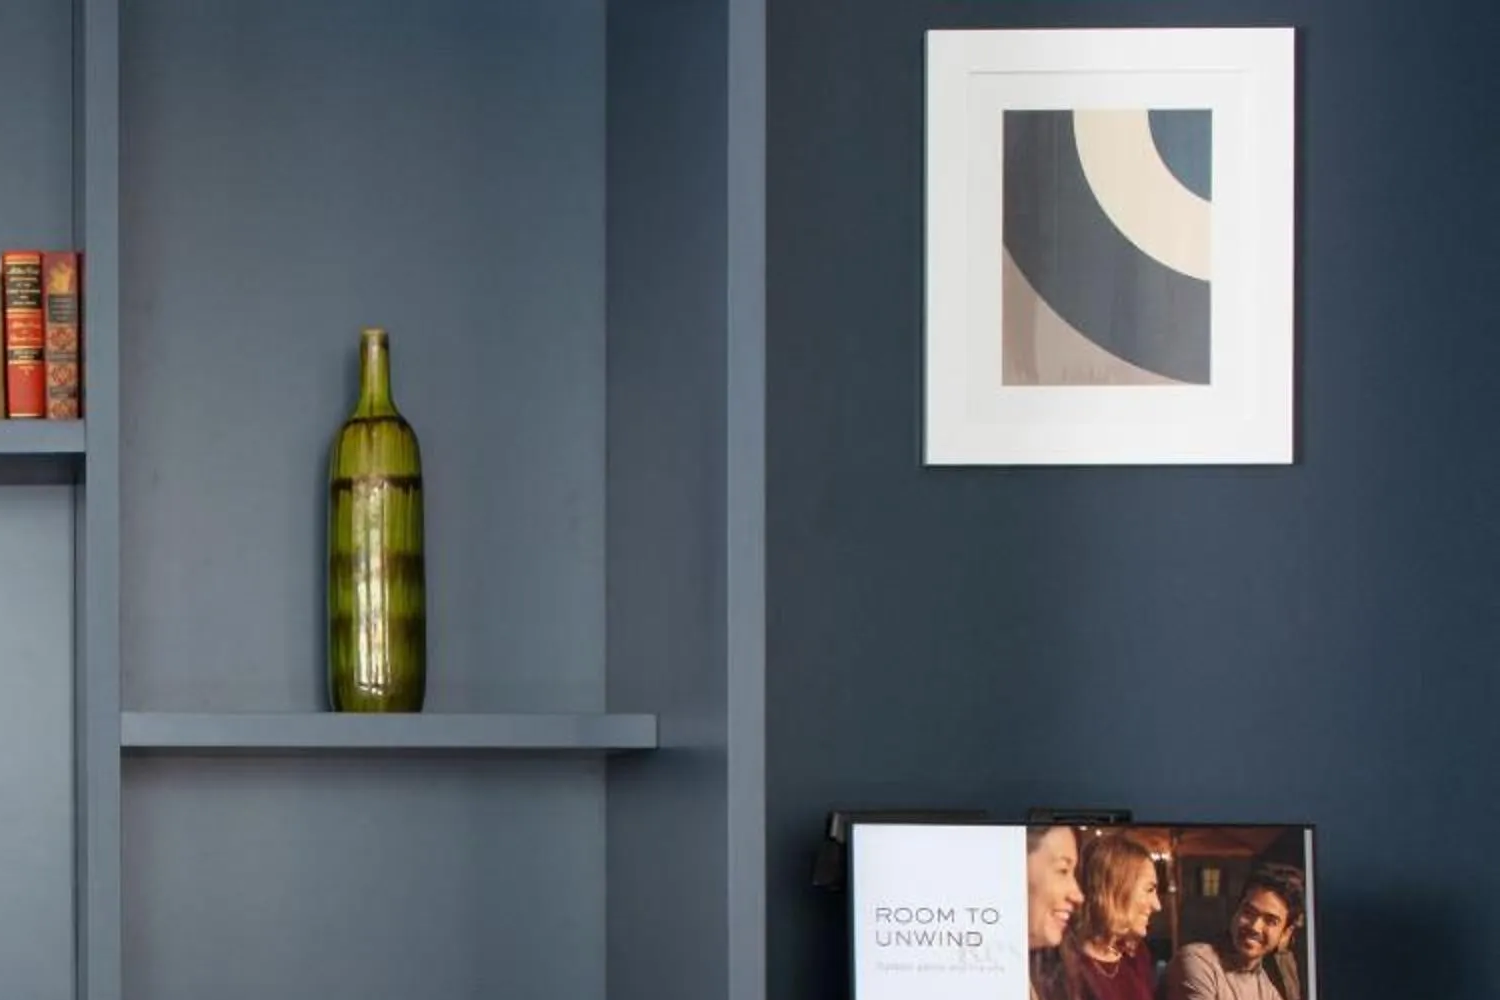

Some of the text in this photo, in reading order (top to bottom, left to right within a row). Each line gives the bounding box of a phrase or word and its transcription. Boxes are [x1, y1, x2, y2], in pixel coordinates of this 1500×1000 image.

[875, 907, 1000, 925] ROOM TO
[875, 931, 983, 947] UNWIND
